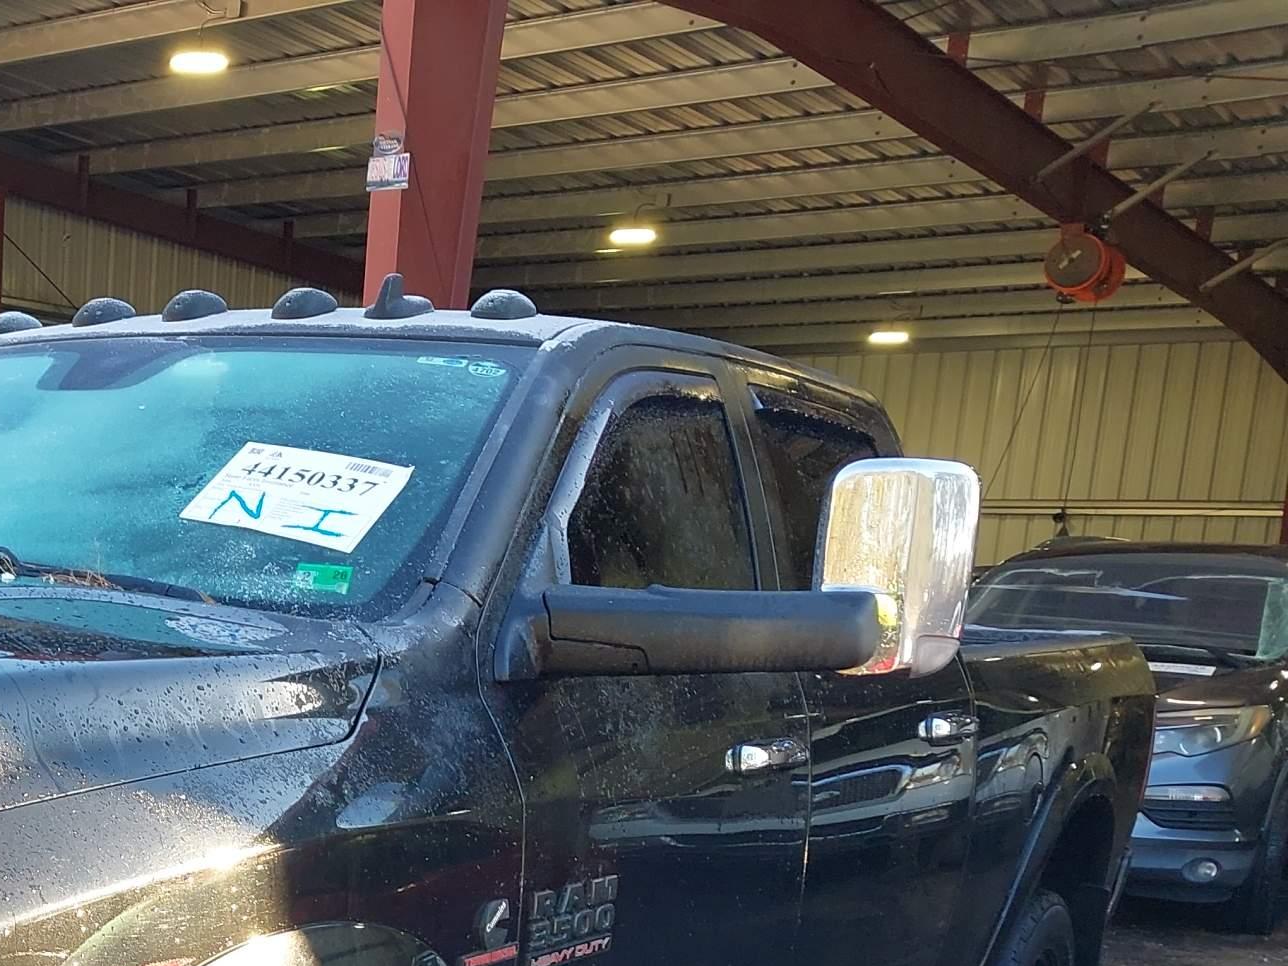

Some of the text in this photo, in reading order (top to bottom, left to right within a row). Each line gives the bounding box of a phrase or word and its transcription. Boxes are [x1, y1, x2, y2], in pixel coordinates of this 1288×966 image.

[241, 461, 379, 496] 44150337
[208, 489, 266, 519] N
[532, 874, 620, 920] RAM
[575, 936, 610, 957] DUTY
